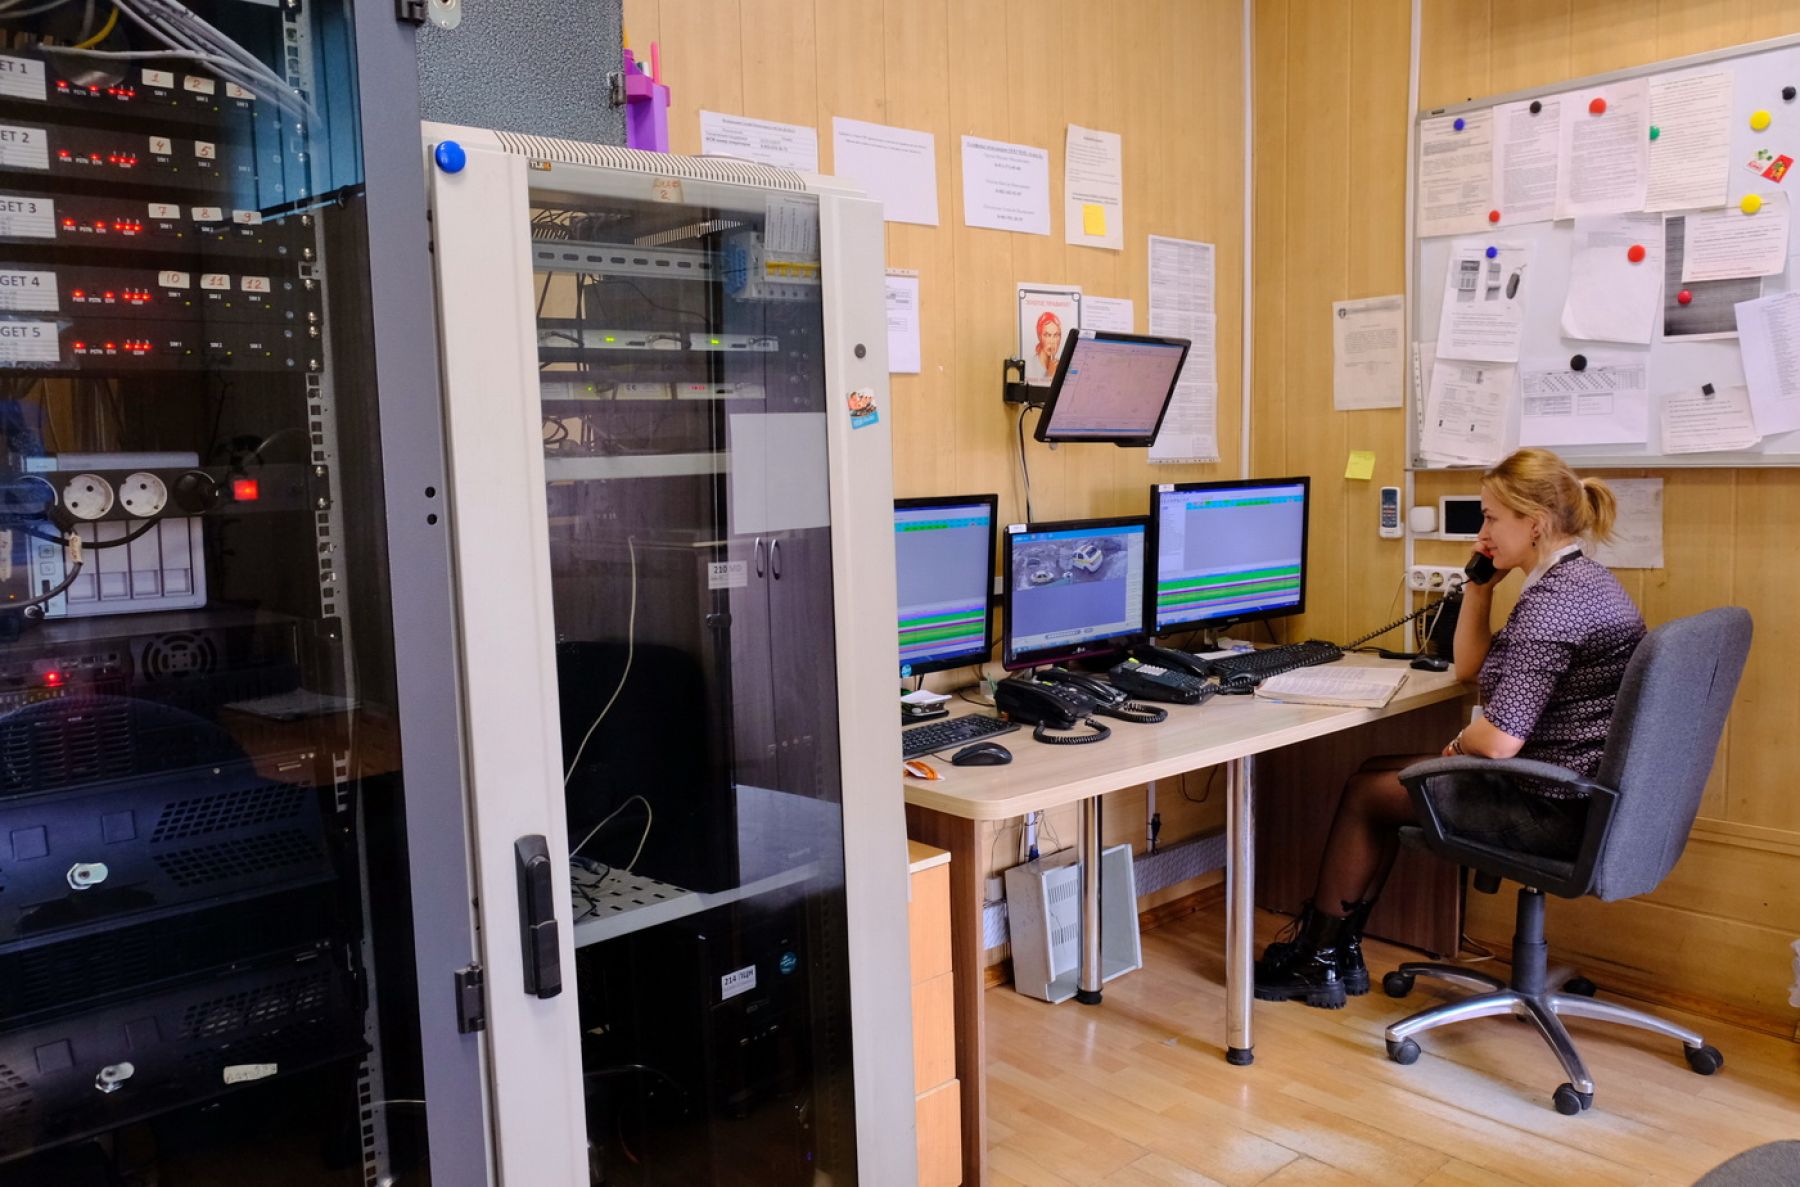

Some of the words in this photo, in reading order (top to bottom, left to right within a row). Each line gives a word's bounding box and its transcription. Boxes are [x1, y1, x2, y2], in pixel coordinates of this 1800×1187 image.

[20, 63, 27, 74] 1
[152, 73, 160, 83] 1
[192, 80, 202, 89] 2
[234, 86, 242, 96] 3
[1, 130, 16, 142] ET
[22, 132, 29, 143] 2
[156, 140, 164, 152] 4
[201, 145, 212, 156] 5
[660, 190, 671, 200] 2
[0, 201, 24, 213] GET
[28, 202, 37, 213] 3
[158, 206, 167, 216] 7
[201, 208, 210, 218] 8
[244, 212, 252, 222] 9
[0, 275, 26, 286] GET
[31, 276, 40, 287] 4
[166, 274, 180, 284] 10
[209, 276, 224, 286] 11
[246, 280, 262, 290] 12
[0, 326, 28, 337] GET
[32, 327, 41, 337] 5
[724, 974, 737, 986] 214
